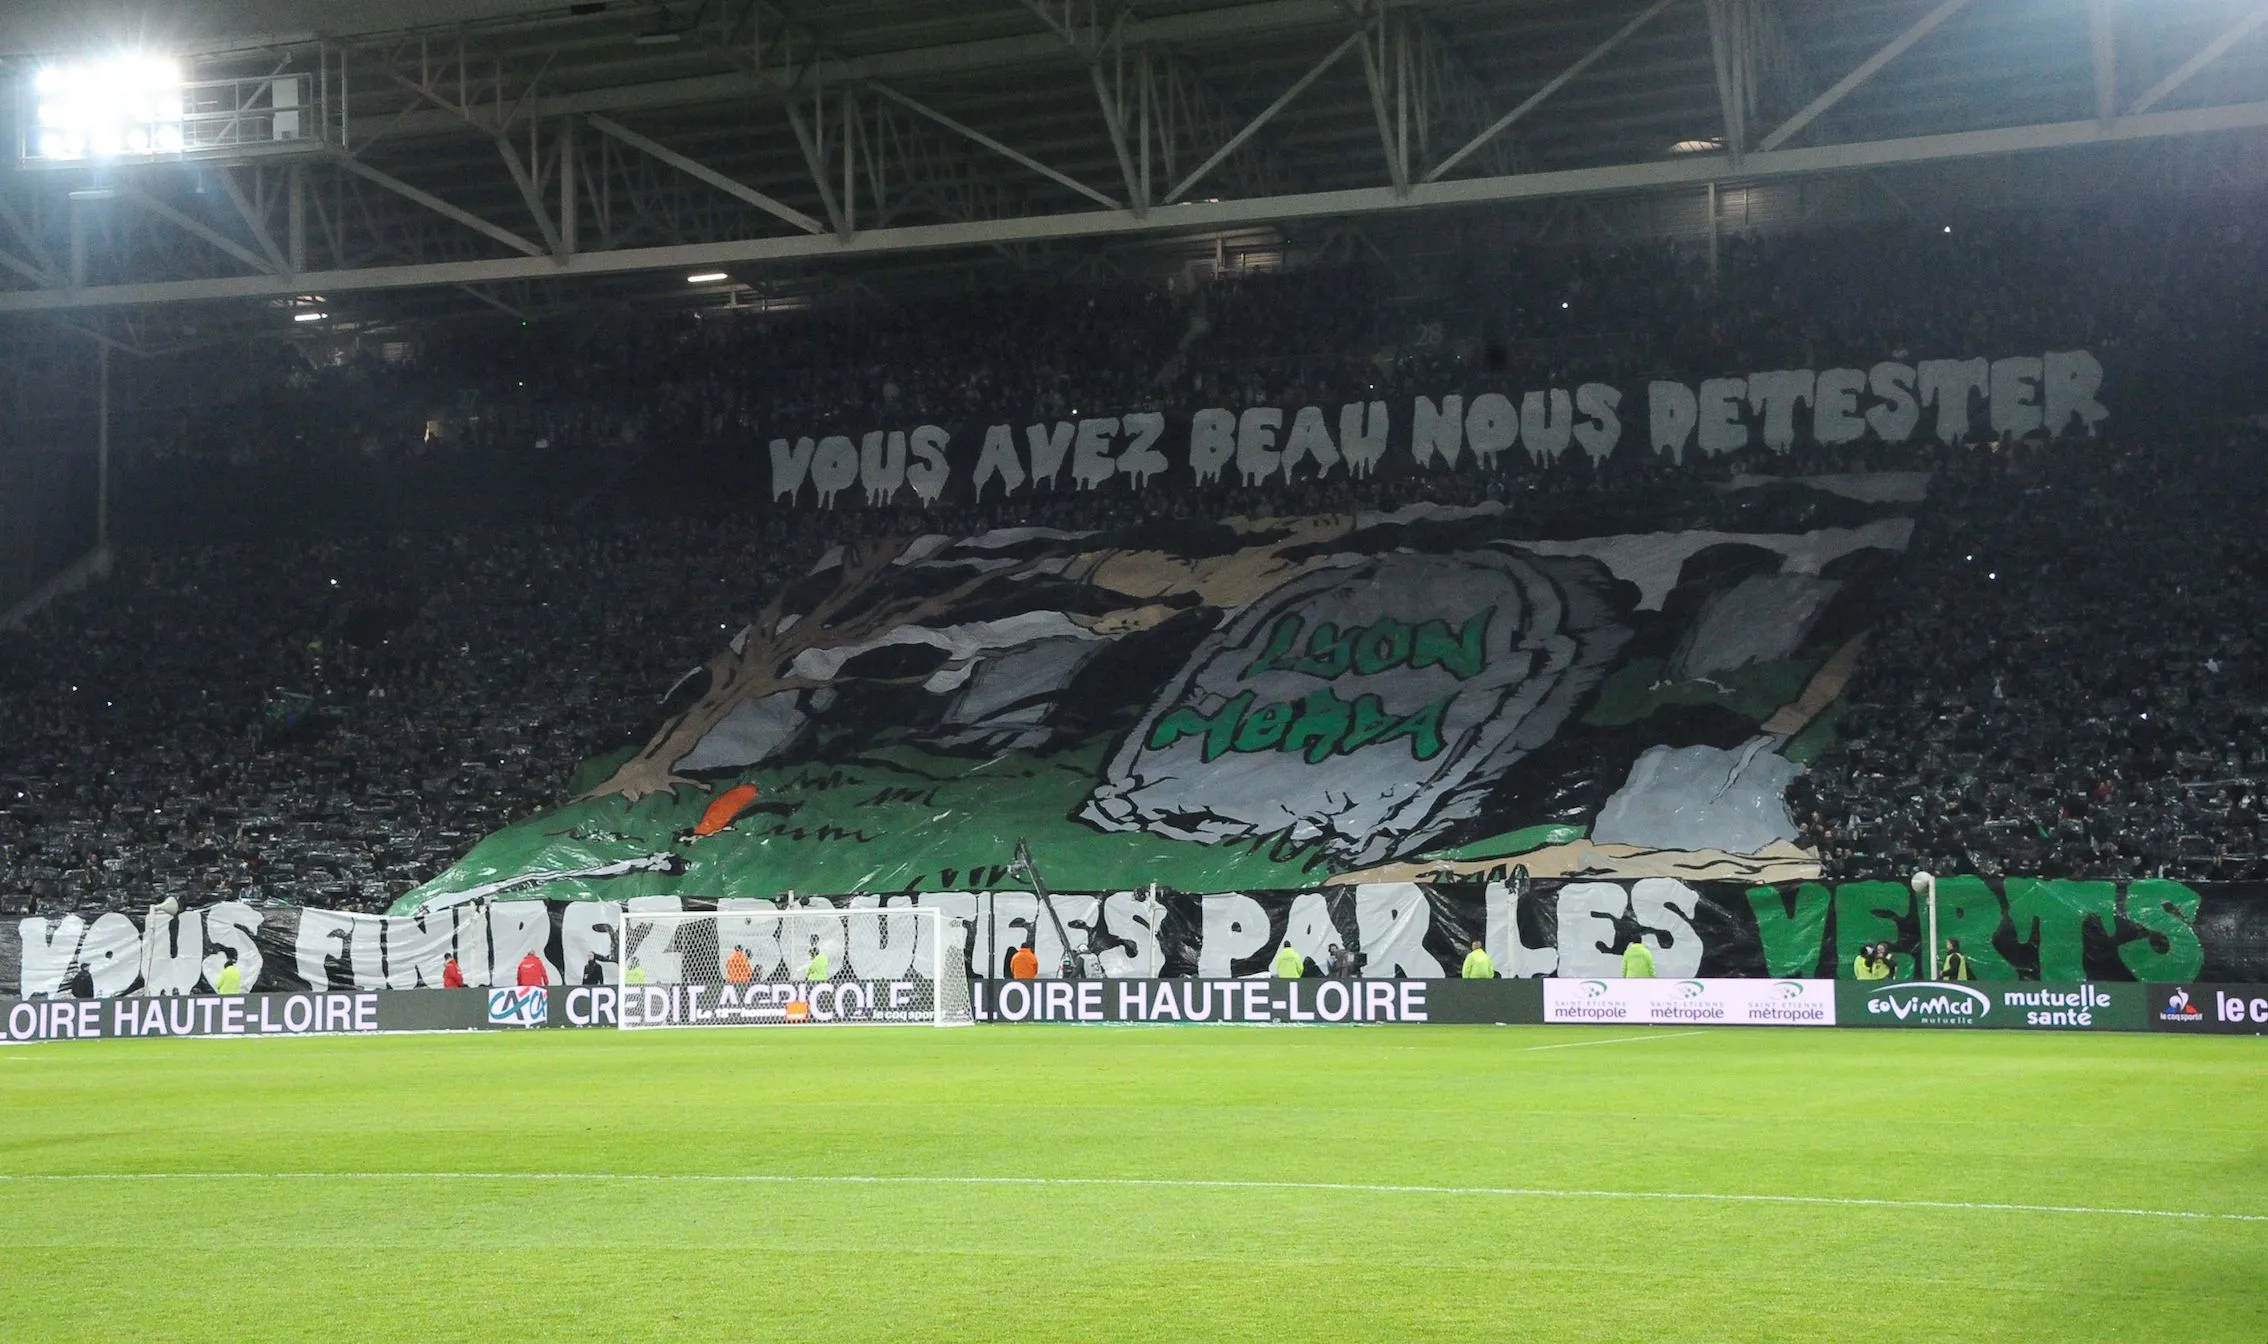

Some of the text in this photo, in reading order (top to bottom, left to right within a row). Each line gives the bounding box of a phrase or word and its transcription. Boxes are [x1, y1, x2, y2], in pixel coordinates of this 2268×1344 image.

[769, 350, 2109, 510] VOUS AVEZ BEAU NOUS DETESTER
[19, 902, 264, 999] VOUS
[1199, 882, 1446, 978] PAR
[1485, 877, 1703, 978] LES
[1746, 876, 2204, 983] VERTS
[975, 981, 1428, 1022] LOIRE HAUTE-LOIRE
[2004, 984, 2111, 1008] mutuelle
[2217, 991, 2245, 1022] le
[114, 994, 378, 1037] HAUTE-LOIRE
[1555, 1006, 1627, 1020] métropole
[1651, 1006, 1724, 1020] métropole
[1748, 1007, 1824, 1021] métropole
[2027, 1007, 2092, 1026] santé
